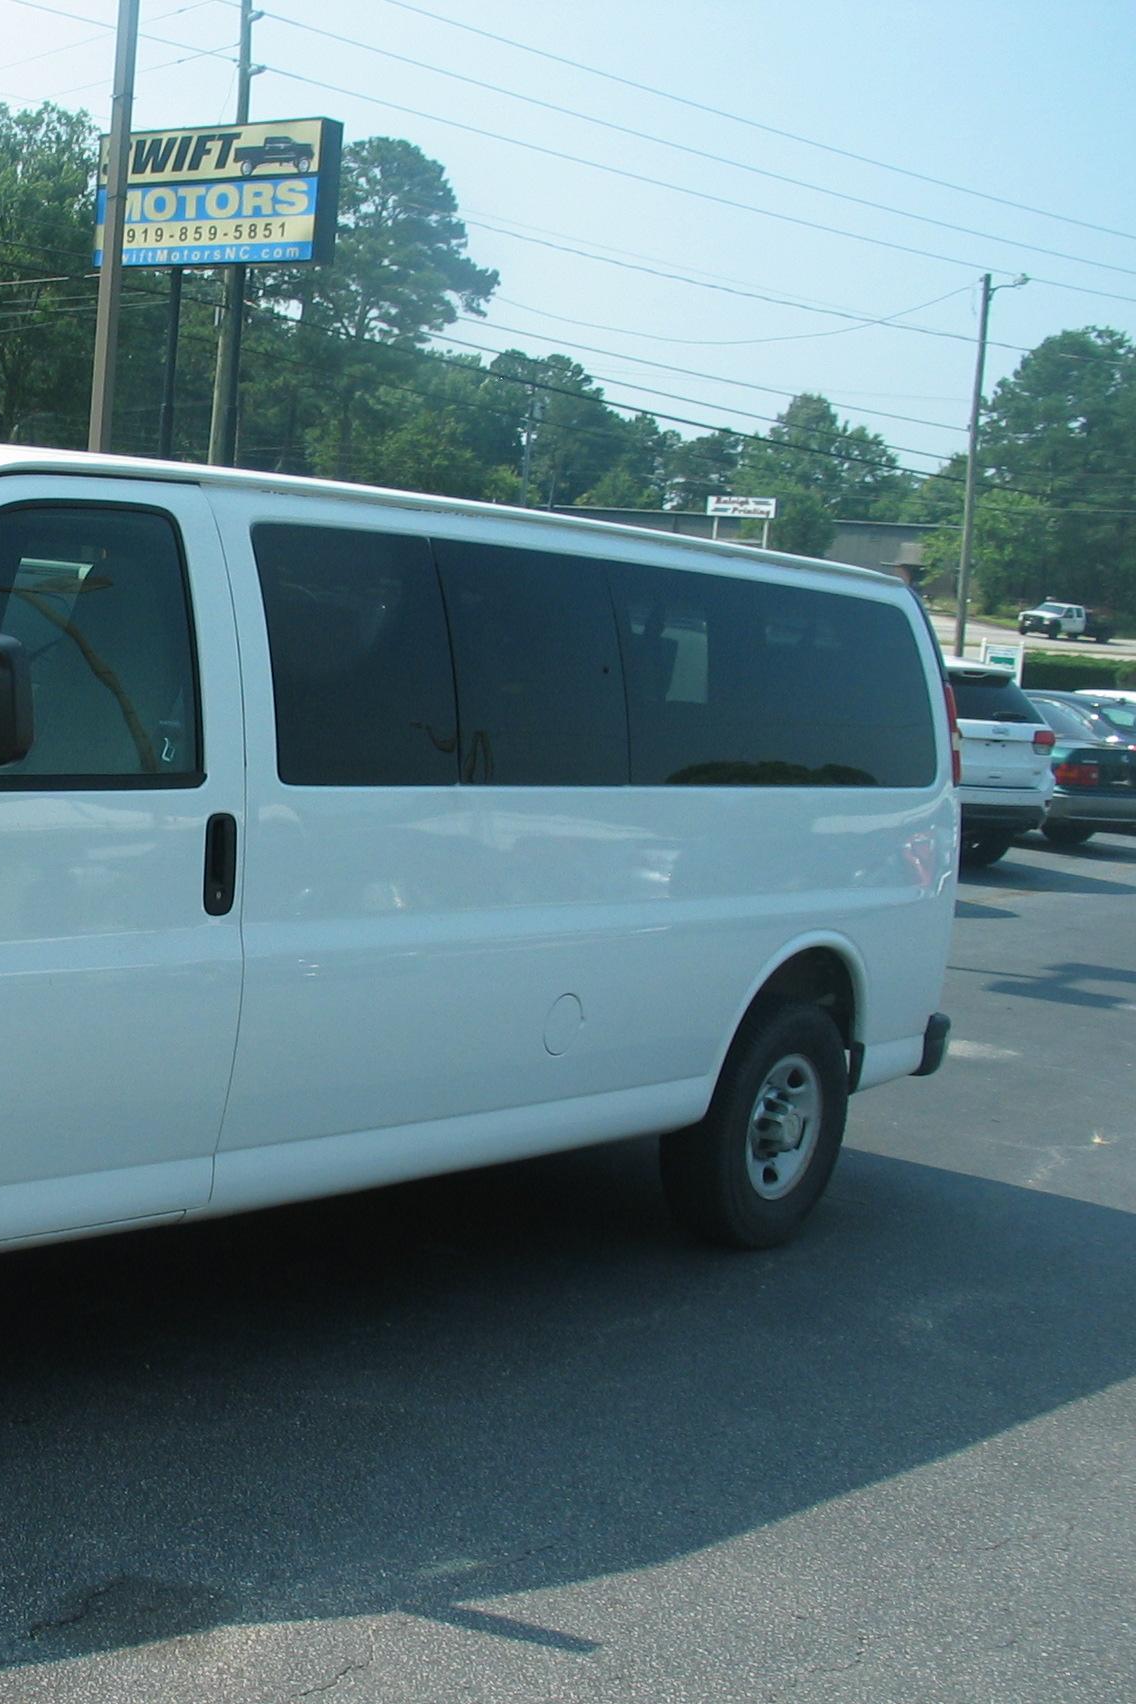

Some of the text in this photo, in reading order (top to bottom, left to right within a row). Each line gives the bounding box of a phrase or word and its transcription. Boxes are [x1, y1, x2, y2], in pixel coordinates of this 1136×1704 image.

[103, 133, 241, 176] WIFT
[127, 222, 286, 243] 919-859-5851
[122, 246, 300, 263] iftMotorsNC.com
